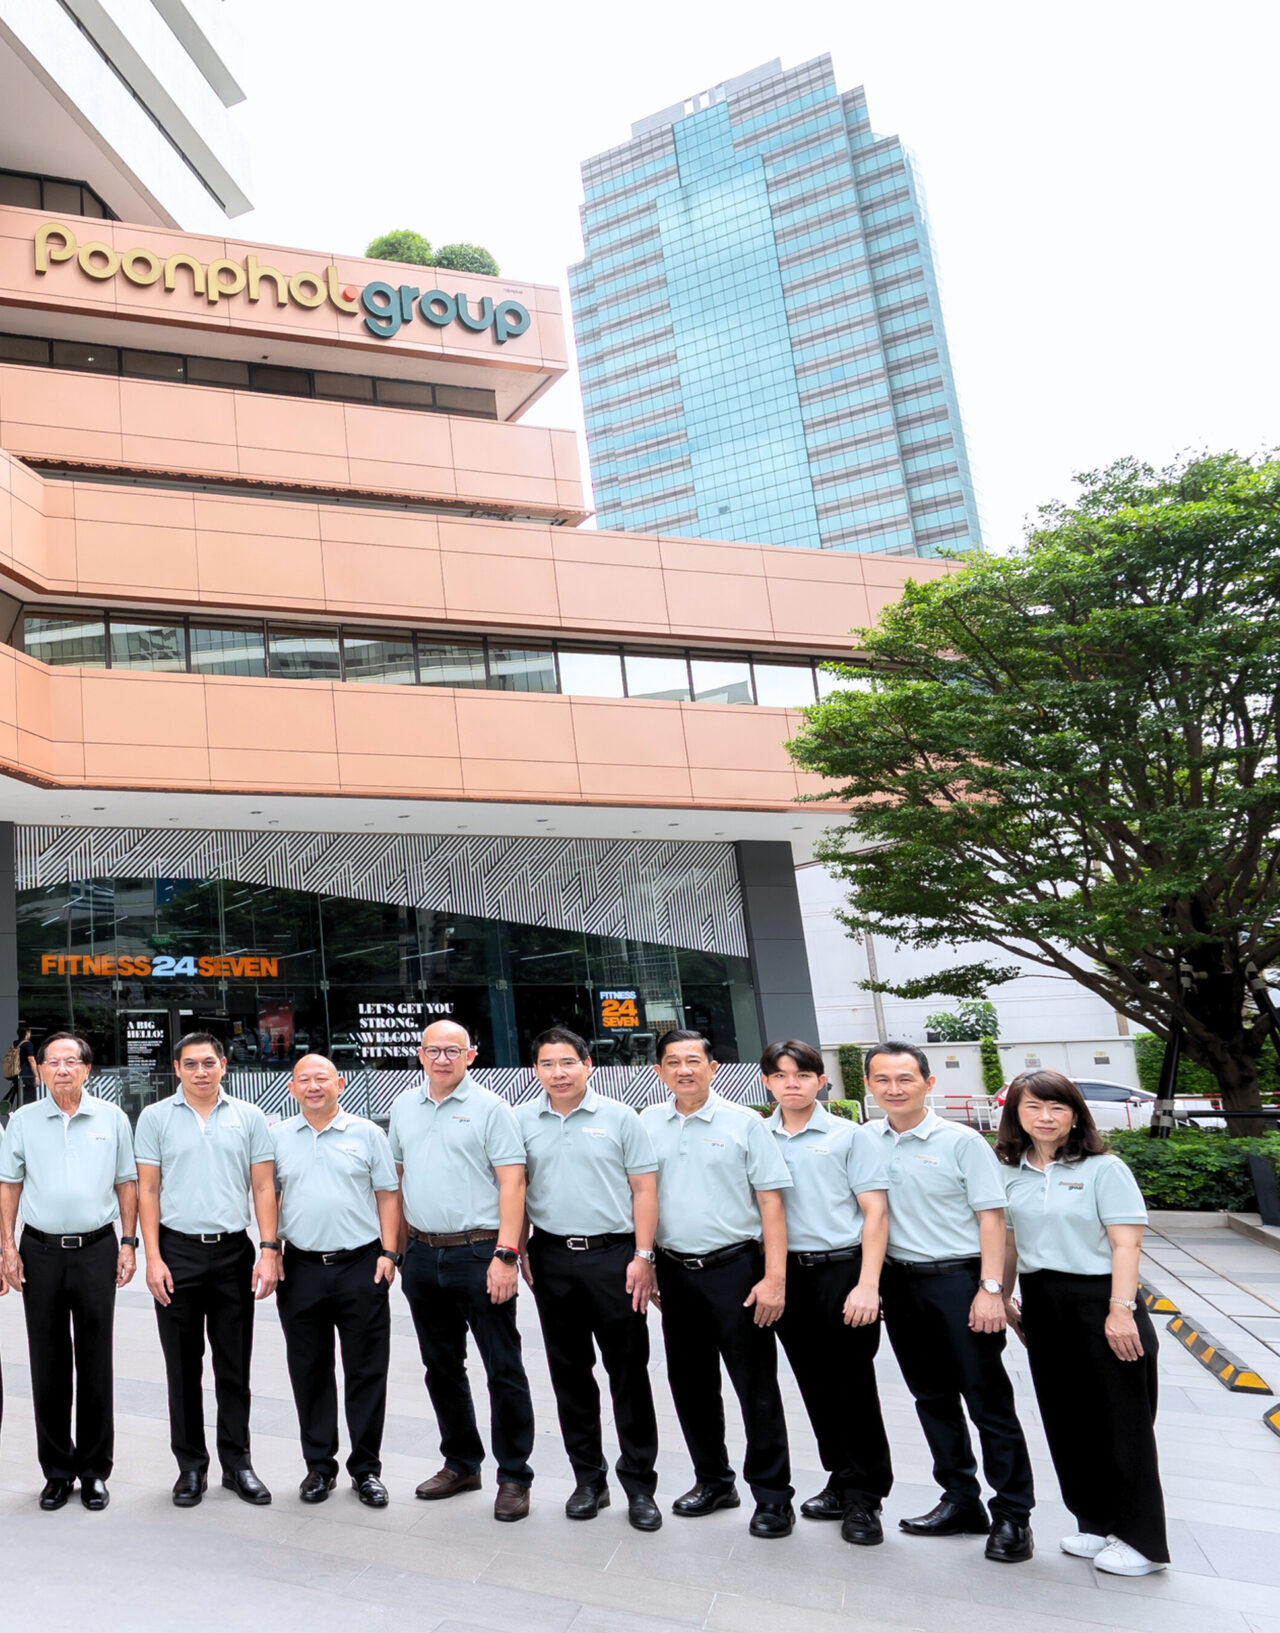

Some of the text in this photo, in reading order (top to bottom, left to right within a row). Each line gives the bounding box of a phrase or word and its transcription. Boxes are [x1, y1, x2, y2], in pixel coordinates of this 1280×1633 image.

[361, 281, 531, 343] group
[600, 991, 637, 1000] FITNESS
[358, 1003, 454, 1014] LET'S GET YOU
[601, 999, 638, 1017] 24
[127, 1021, 156, 1030] A BIG
[359, 1017, 419, 1028] STRONG.
[602, 1016, 639, 1027] SEVEN
[127, 1030, 165, 1039] HELLO!
[361, 1032, 424, 1043] WELCOM
[361, 1046, 422, 1058] FITNESS
